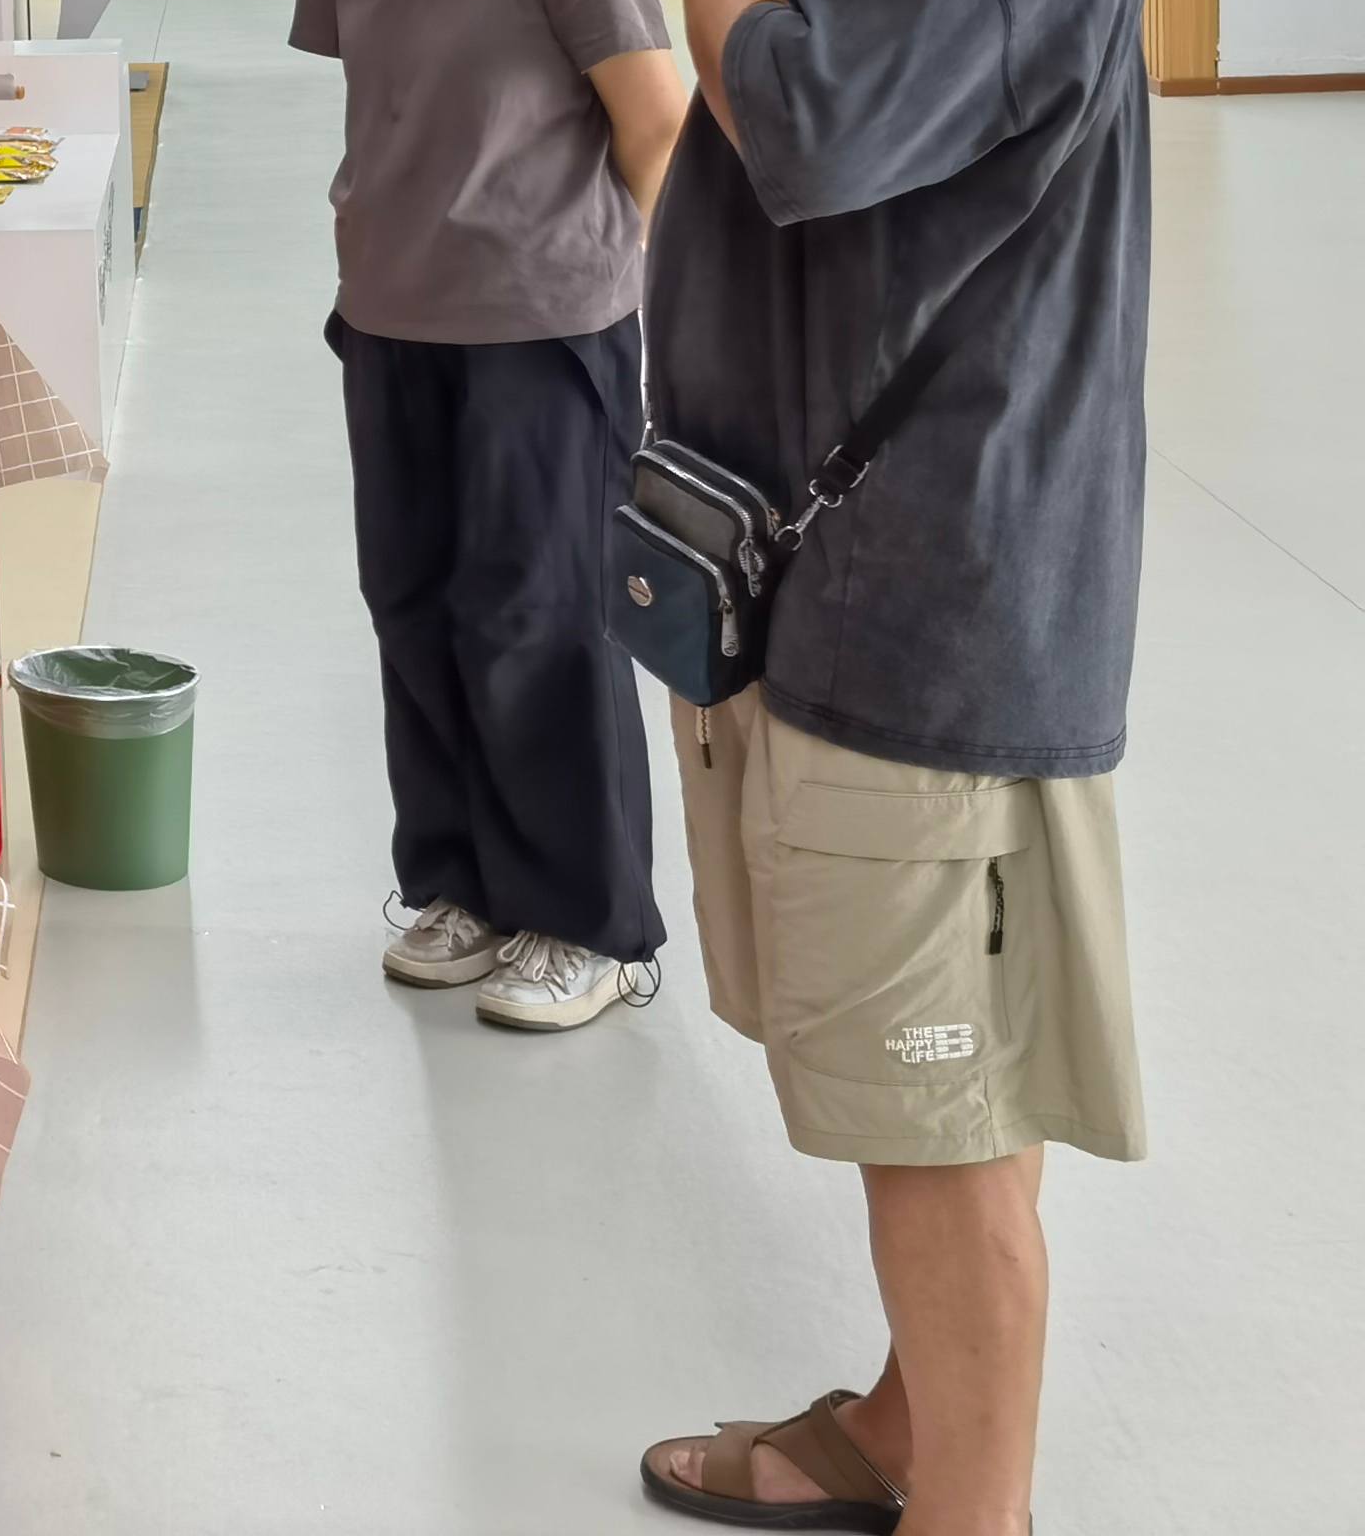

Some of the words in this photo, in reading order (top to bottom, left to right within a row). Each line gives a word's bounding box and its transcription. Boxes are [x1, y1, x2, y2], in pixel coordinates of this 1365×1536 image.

[902, 1026, 934, 1040] THE
[885, 1038, 933, 1052] HAPPY
[902, 1049, 935, 1064] LIFE
